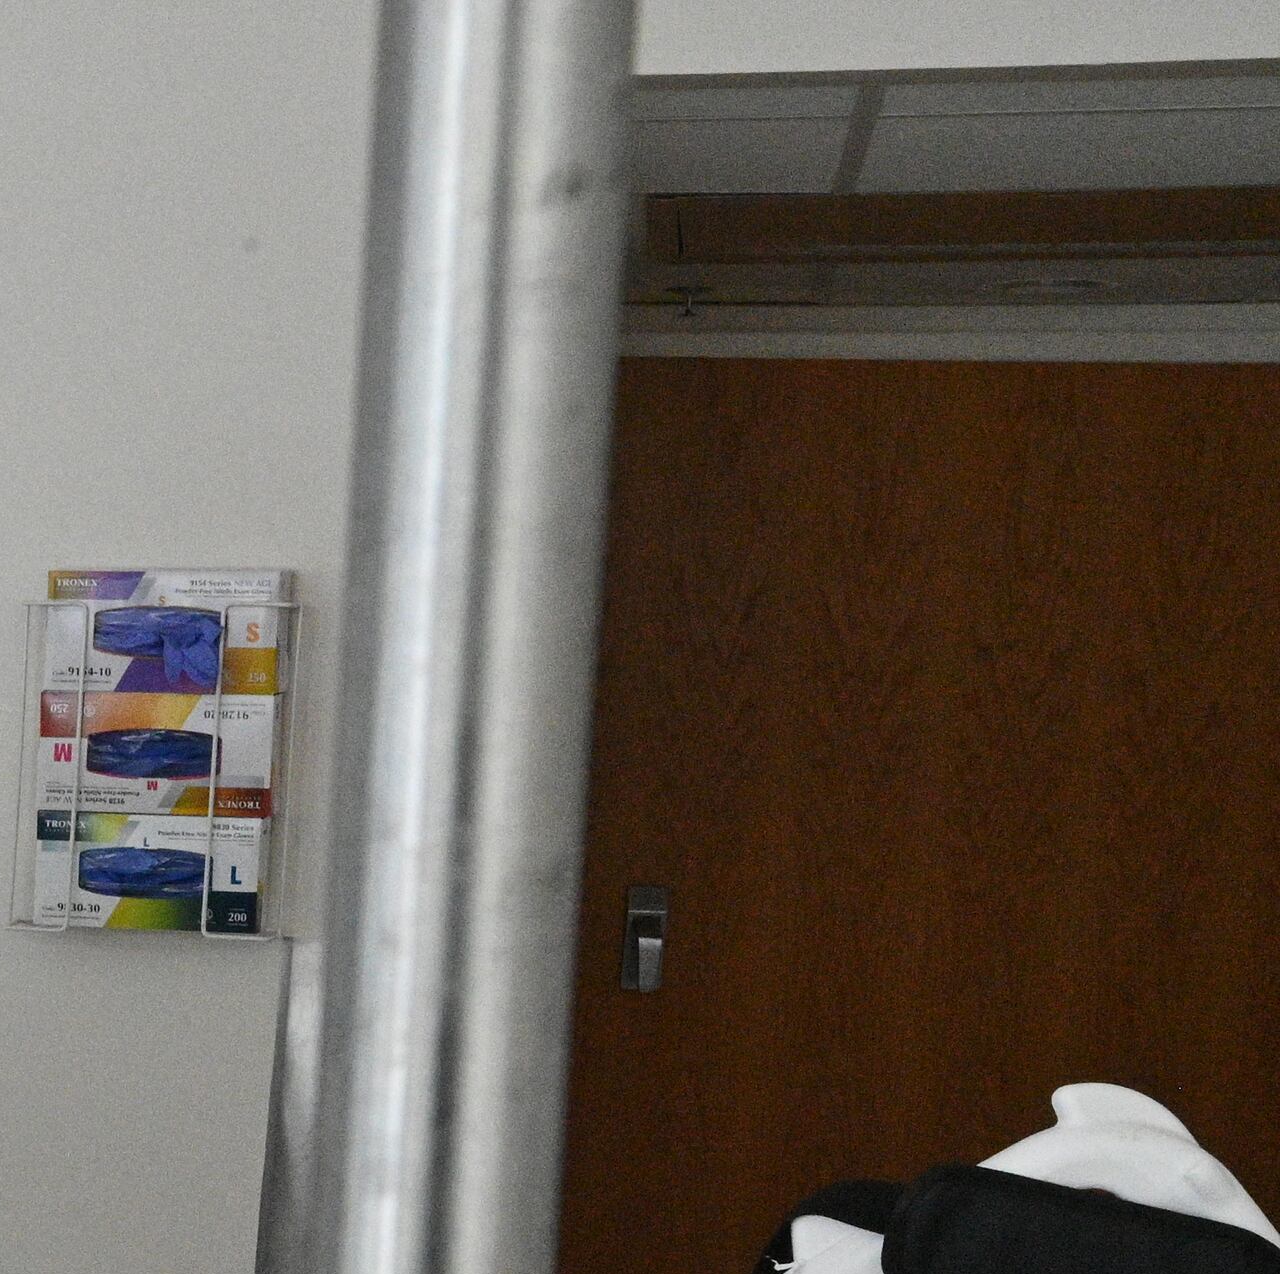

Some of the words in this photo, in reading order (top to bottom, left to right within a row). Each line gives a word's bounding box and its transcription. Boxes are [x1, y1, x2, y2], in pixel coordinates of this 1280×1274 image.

[56, 578, 98, 587] TRONEX
[246, 622, 260, 643] S
[50, 703, 69, 714] 250
[53, 742, 73, 763] M
[146, 780, 159, 791] M
[217, 800, 261, 809] TRONEX
[45, 819, 86, 829] TRONX
[143, 836, 150, 848] L
[230, 865, 242, 885] L
[57, 902, 101, 913] 930-30
[227, 911, 247, 922] 200
